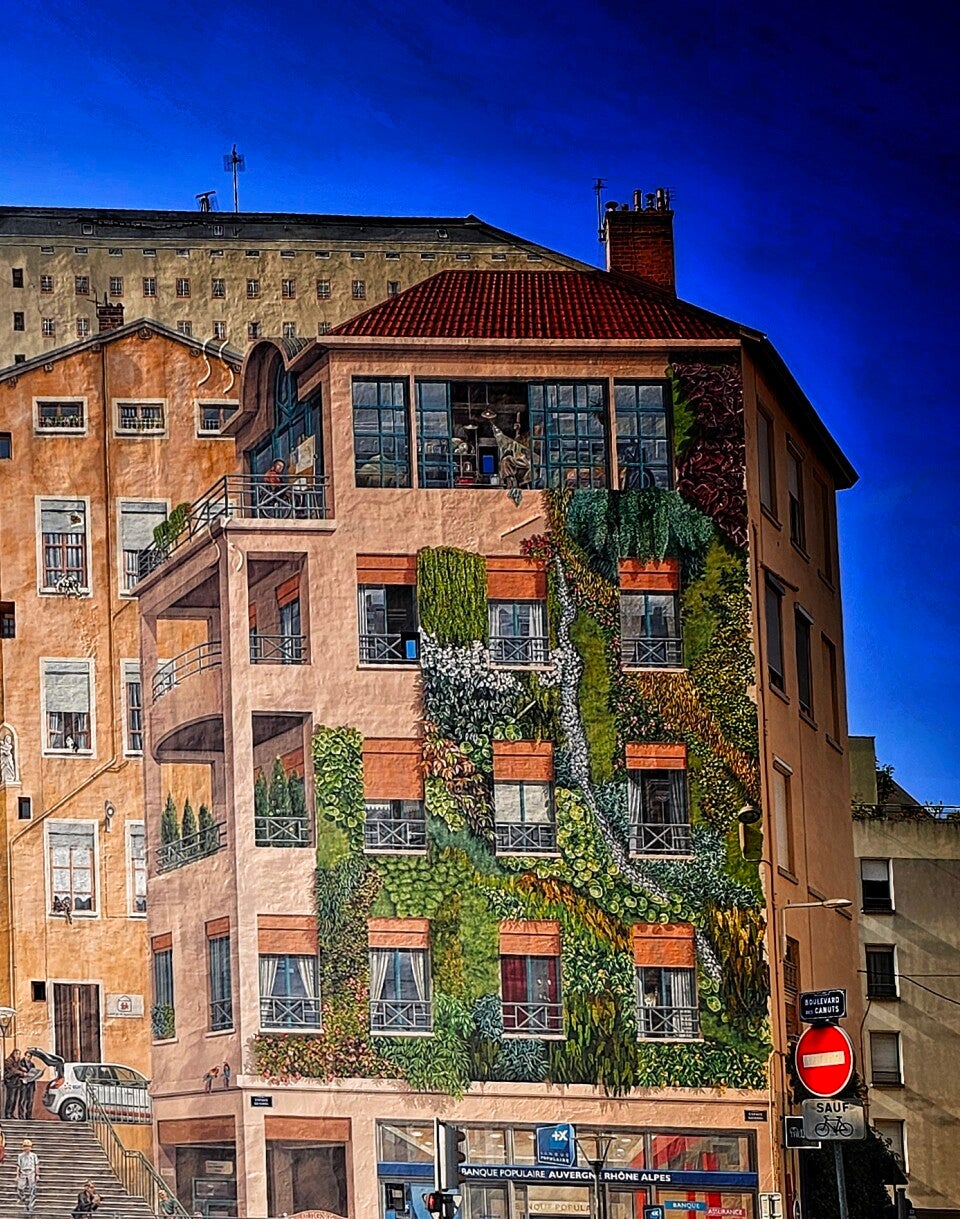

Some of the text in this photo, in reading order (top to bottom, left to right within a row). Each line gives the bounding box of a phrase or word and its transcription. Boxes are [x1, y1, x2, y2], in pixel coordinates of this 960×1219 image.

[804, 997, 840, 1006] BOULEVARD
[814, 1005, 840, 1015] CANUTS
[816, 1102, 850, 1114] SAUF
[461, 1167, 499, 1178] BANQUE
[499, 1169, 546, 1179] POPULAIRE
[604, 1170, 639, 1181] RHÔNE
[641, 1173, 672, 1182] ALPES
[672, 1202, 700, 1210] BANQUE
[707, 1208, 743, 1216] ASSURANCE
